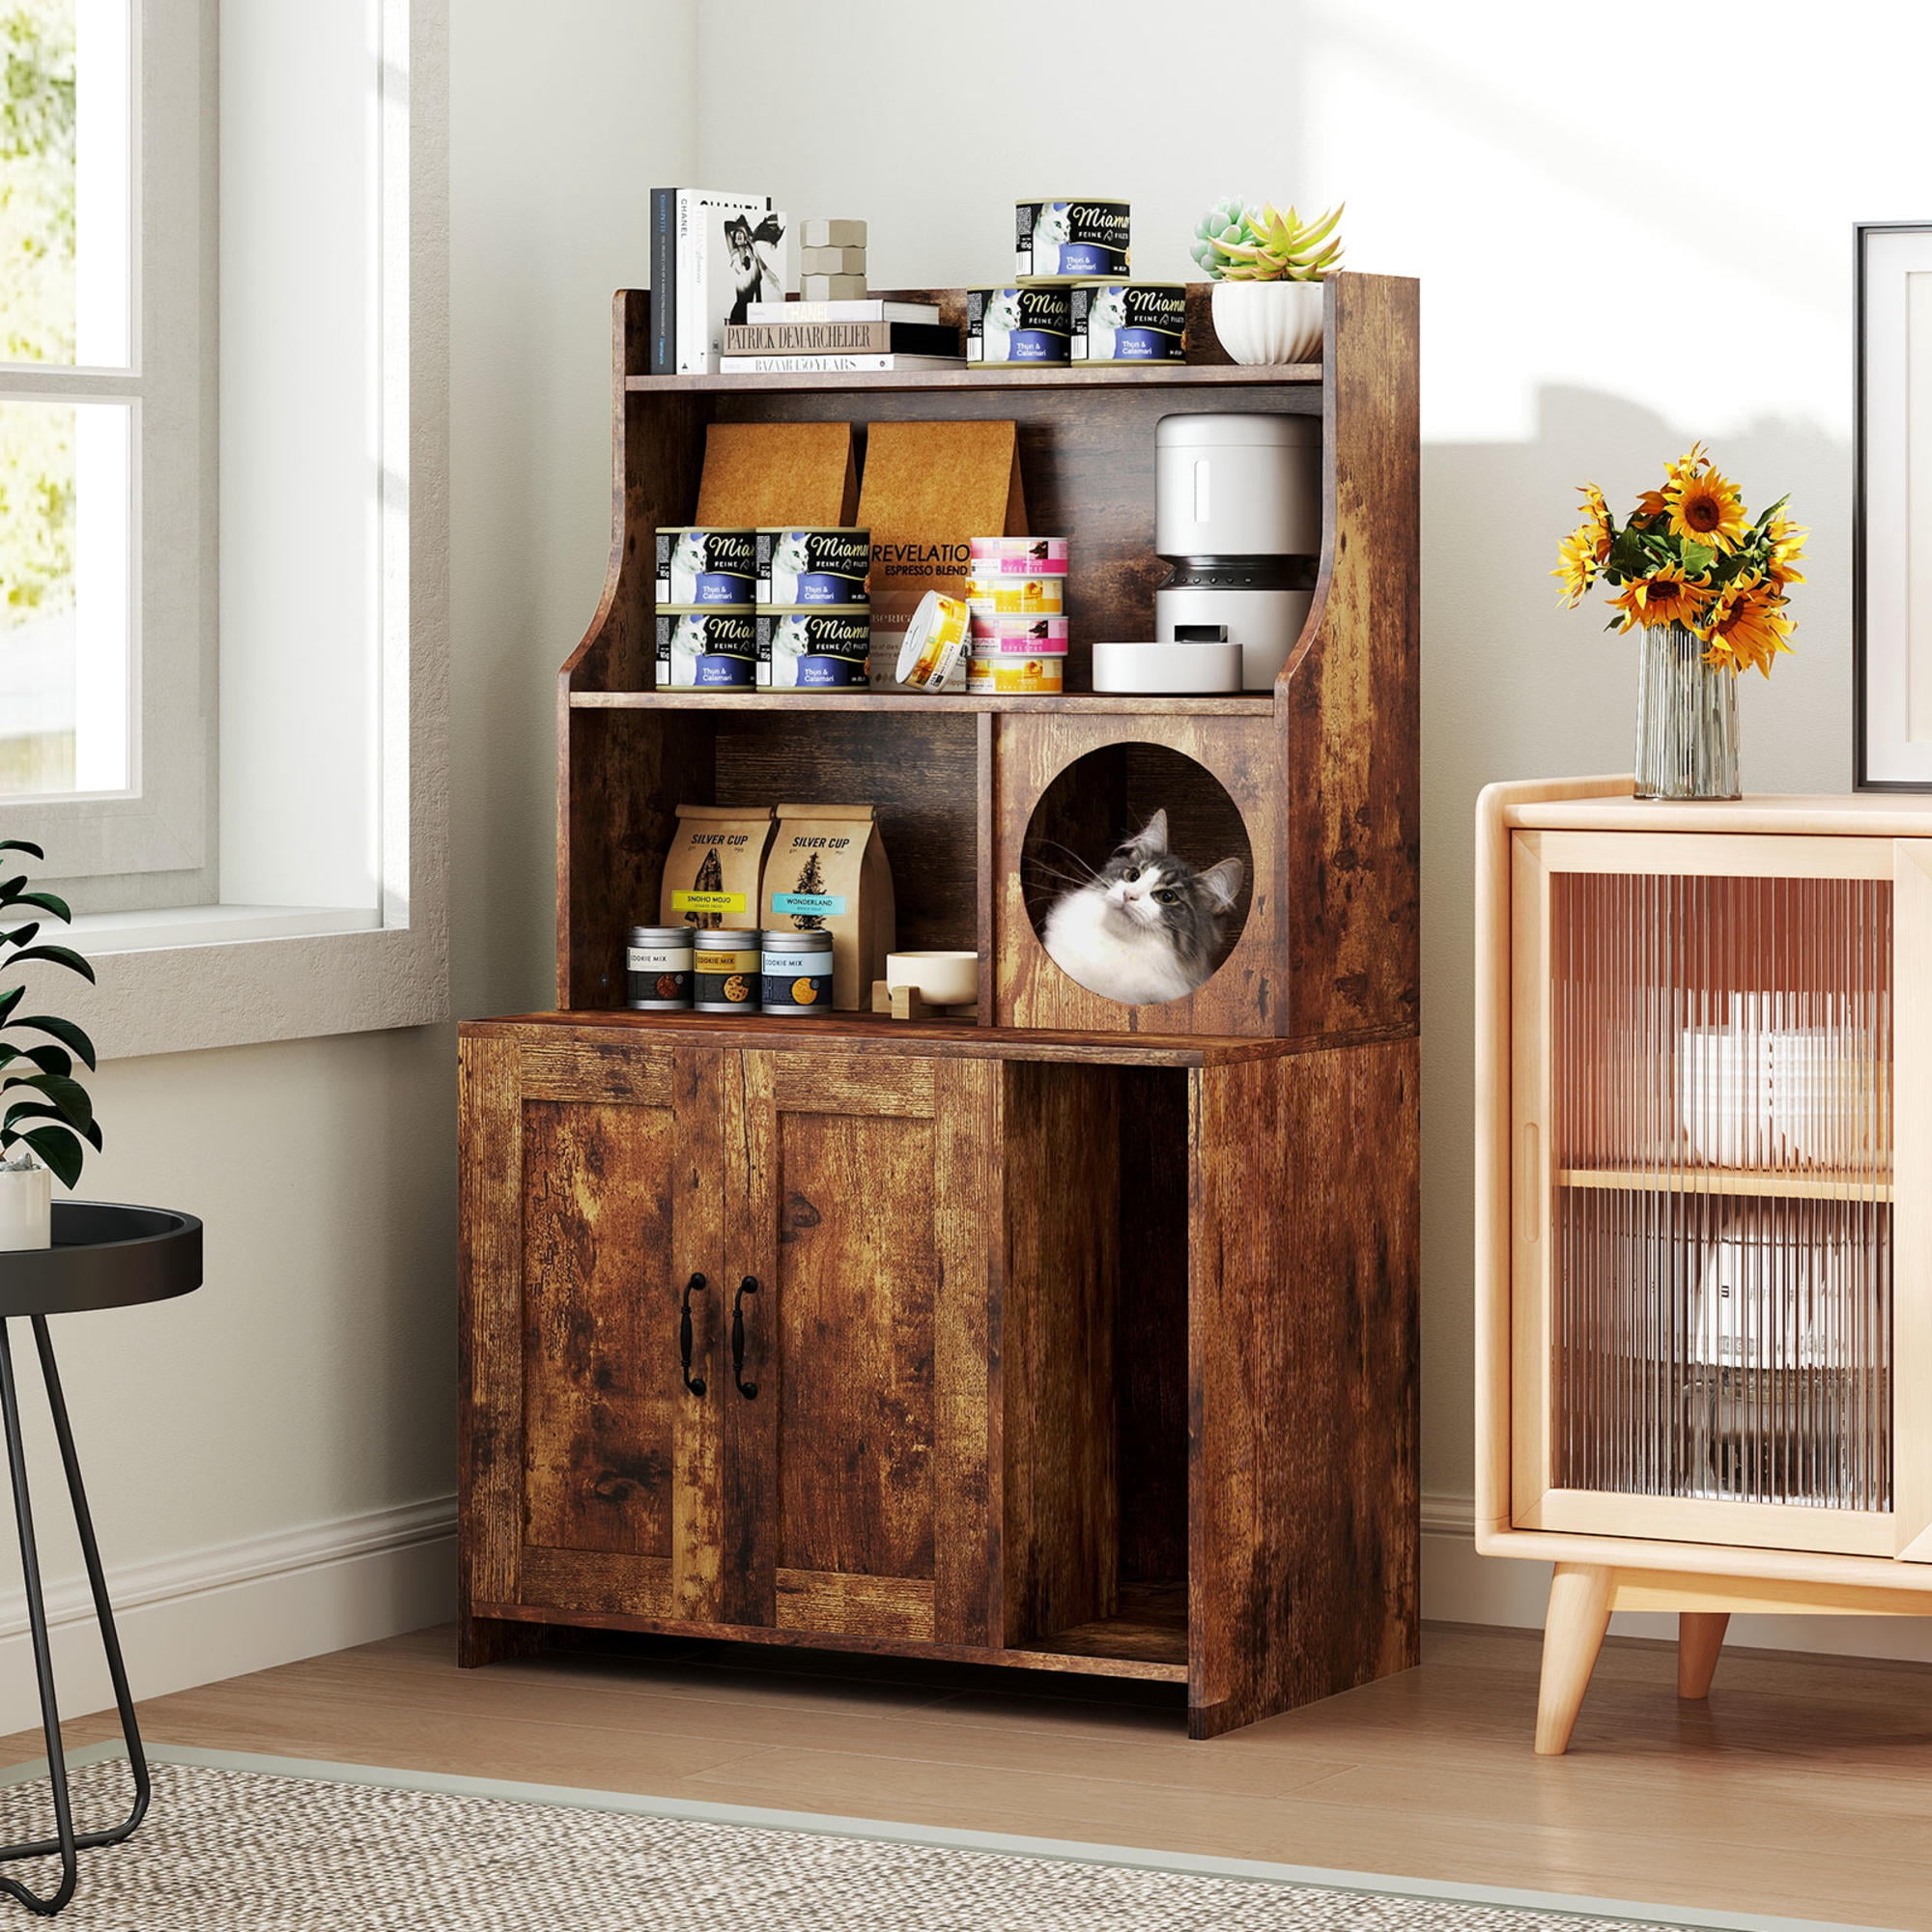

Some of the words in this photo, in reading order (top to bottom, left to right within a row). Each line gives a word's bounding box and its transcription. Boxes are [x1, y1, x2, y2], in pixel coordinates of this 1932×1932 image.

[726, 327, 775, 350] PATRICK
[778, 325, 870, 349] DEMARCHELIER
[871, 544, 970, 562] REVELATIO
[885, 565, 933, 576] ESPRESSO
[935, 565, 968, 576] BLEND
[691, 834, 725, 844] SILVER
[726, 835, 749, 845] CUP
[792, 837, 827, 847] SILVER
[828, 838, 850, 849] CUP
[786, 897, 833, 906] WONDERLAND
